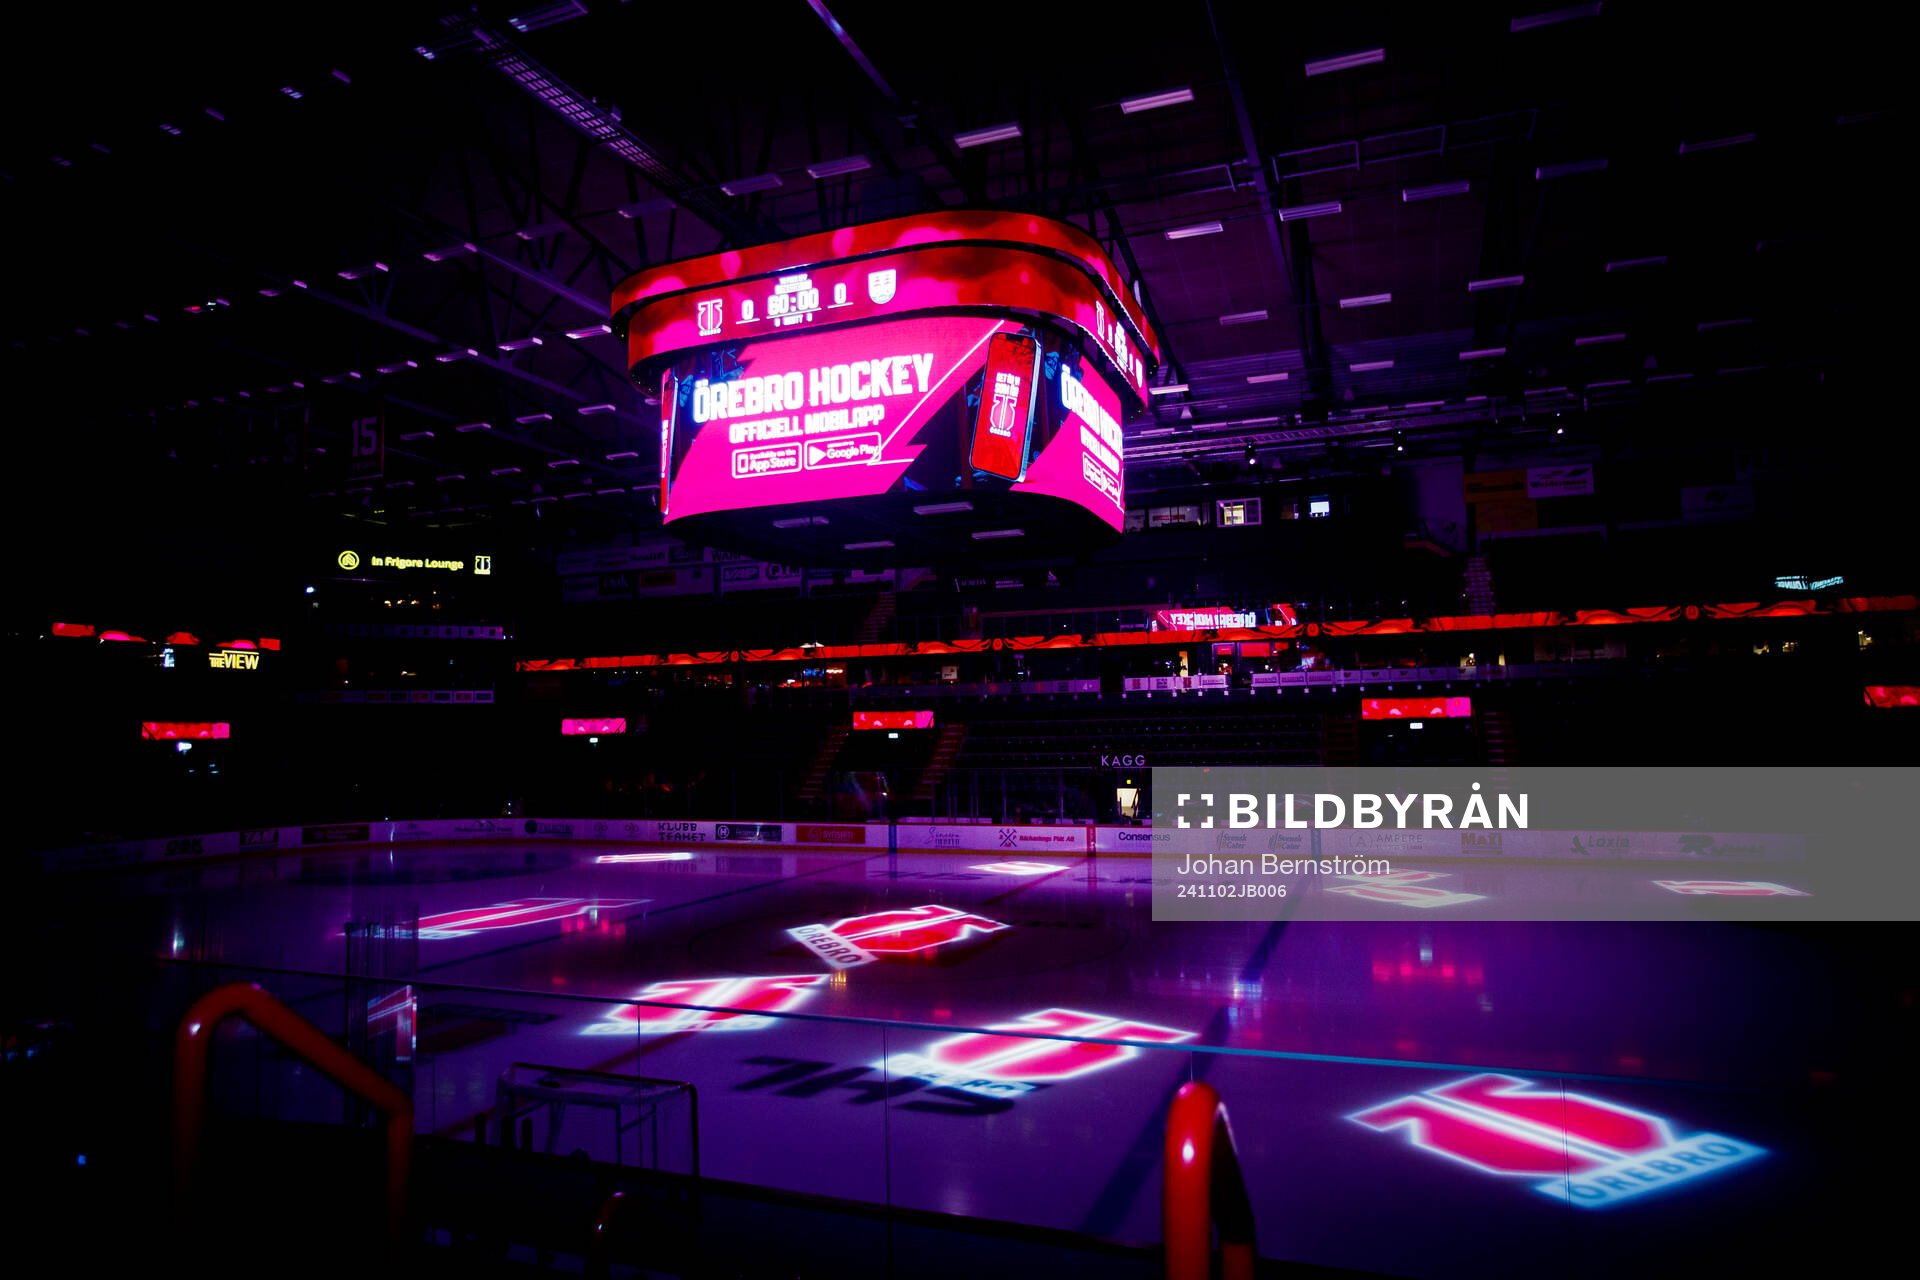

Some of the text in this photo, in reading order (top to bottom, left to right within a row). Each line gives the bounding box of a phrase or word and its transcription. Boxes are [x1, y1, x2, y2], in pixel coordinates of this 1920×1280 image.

[833, 282, 847, 304] 0
[693, 353, 934, 423] ÖREBRO HOCKEY
[729, 404, 885, 444] OFFICIELL MOBILAPP
[352, 416, 378, 458] 15
[826, 447, 859, 459] Google
[860, 444, 880, 456] Play
[750, 456, 797, 472] App Store
[425, 559, 464, 571] Lounge
[225, 653, 260, 670] VIEW
[1101, 754, 1145, 767] KAGG
[658, 822, 698, 831] KLUBB
[1118, 831, 1171, 842] Consensus
